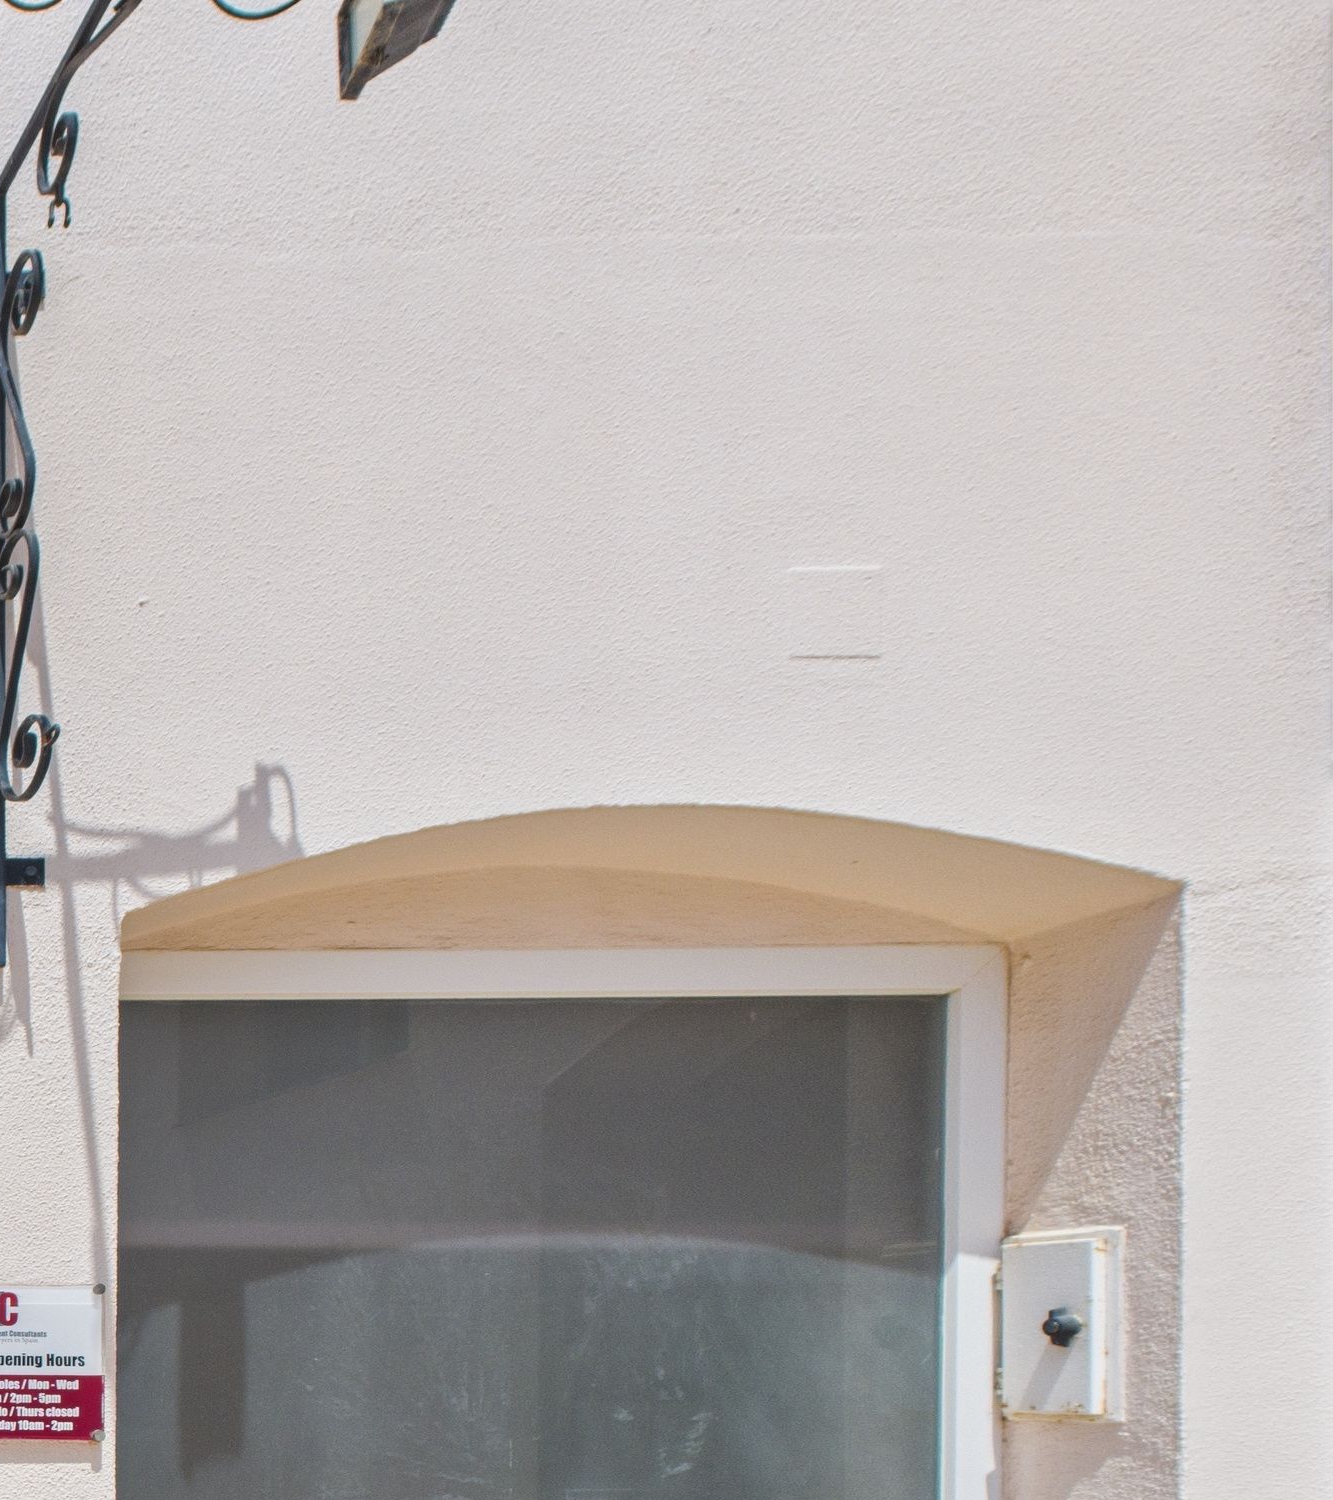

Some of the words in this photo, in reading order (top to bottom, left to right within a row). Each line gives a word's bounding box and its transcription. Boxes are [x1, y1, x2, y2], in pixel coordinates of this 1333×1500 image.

[9, 1330, 47, 1338] Consultants
[46, 1353, 85, 1367] Hours
[21, 1379, 27, 1390] /
[28, 1379, 49, 1390] Mon
[56, 1379, 79, 1390] Wed
[3, 1393, 9, 1404] /
[10, 1393, 32, 1404] 2pm
[38, 1393, 61, 1404] 5pm
[9, 1406, 15, 1417] /
[16, 1406, 44, 1417] Thurs
[46, 1406, 80, 1418] closed
[18, 1420, 44, 1431] 10am
[51, 1420, 74, 1431] 2pm
